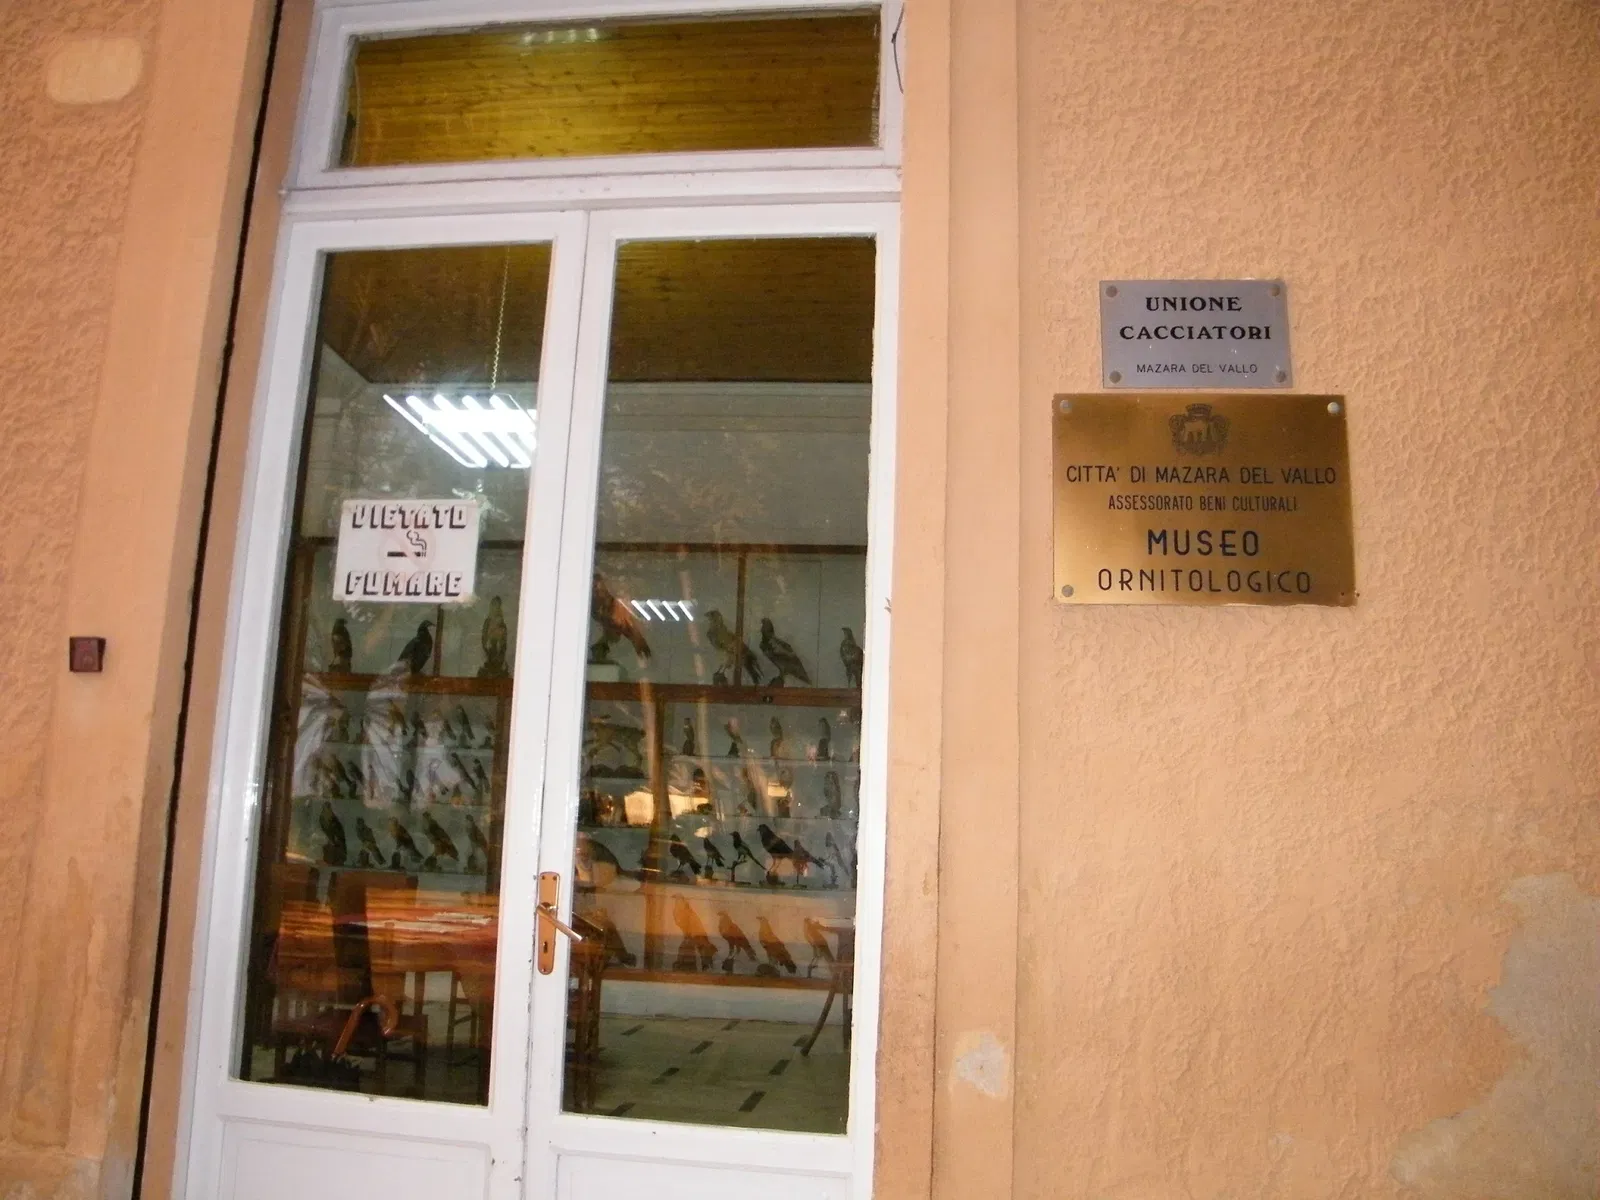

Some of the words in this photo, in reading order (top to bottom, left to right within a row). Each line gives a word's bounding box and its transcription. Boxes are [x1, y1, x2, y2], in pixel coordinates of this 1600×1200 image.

[1145, 296, 1242, 312] UNIONE
[1119, 325, 1272, 340] CACCIATORI
[1136, 363, 1187, 374] MAZARA
[1192, 363, 1215, 374] DEL
[1219, 363, 1259, 374] VALLO
[1066, 465, 1121, 483] CITTA'
[1130, 466, 1146, 484] DI
[1155, 466, 1231, 484] MAZARA
[1239, 467, 1274, 485] DEL
[1281, 467, 1336, 485] VALLO
[1108, 495, 1193, 511] ASSESSORATO
[1199, 496, 1226, 511] BENI
[1232, 496, 1298, 512] CULTURALI
[351, 503, 469, 530] VIETATO
[1147, 529, 1260, 557] MUSEO
[344, 570, 464, 597] FUMARE
[1097, 568, 1312, 594] ORNITOLOGICO
